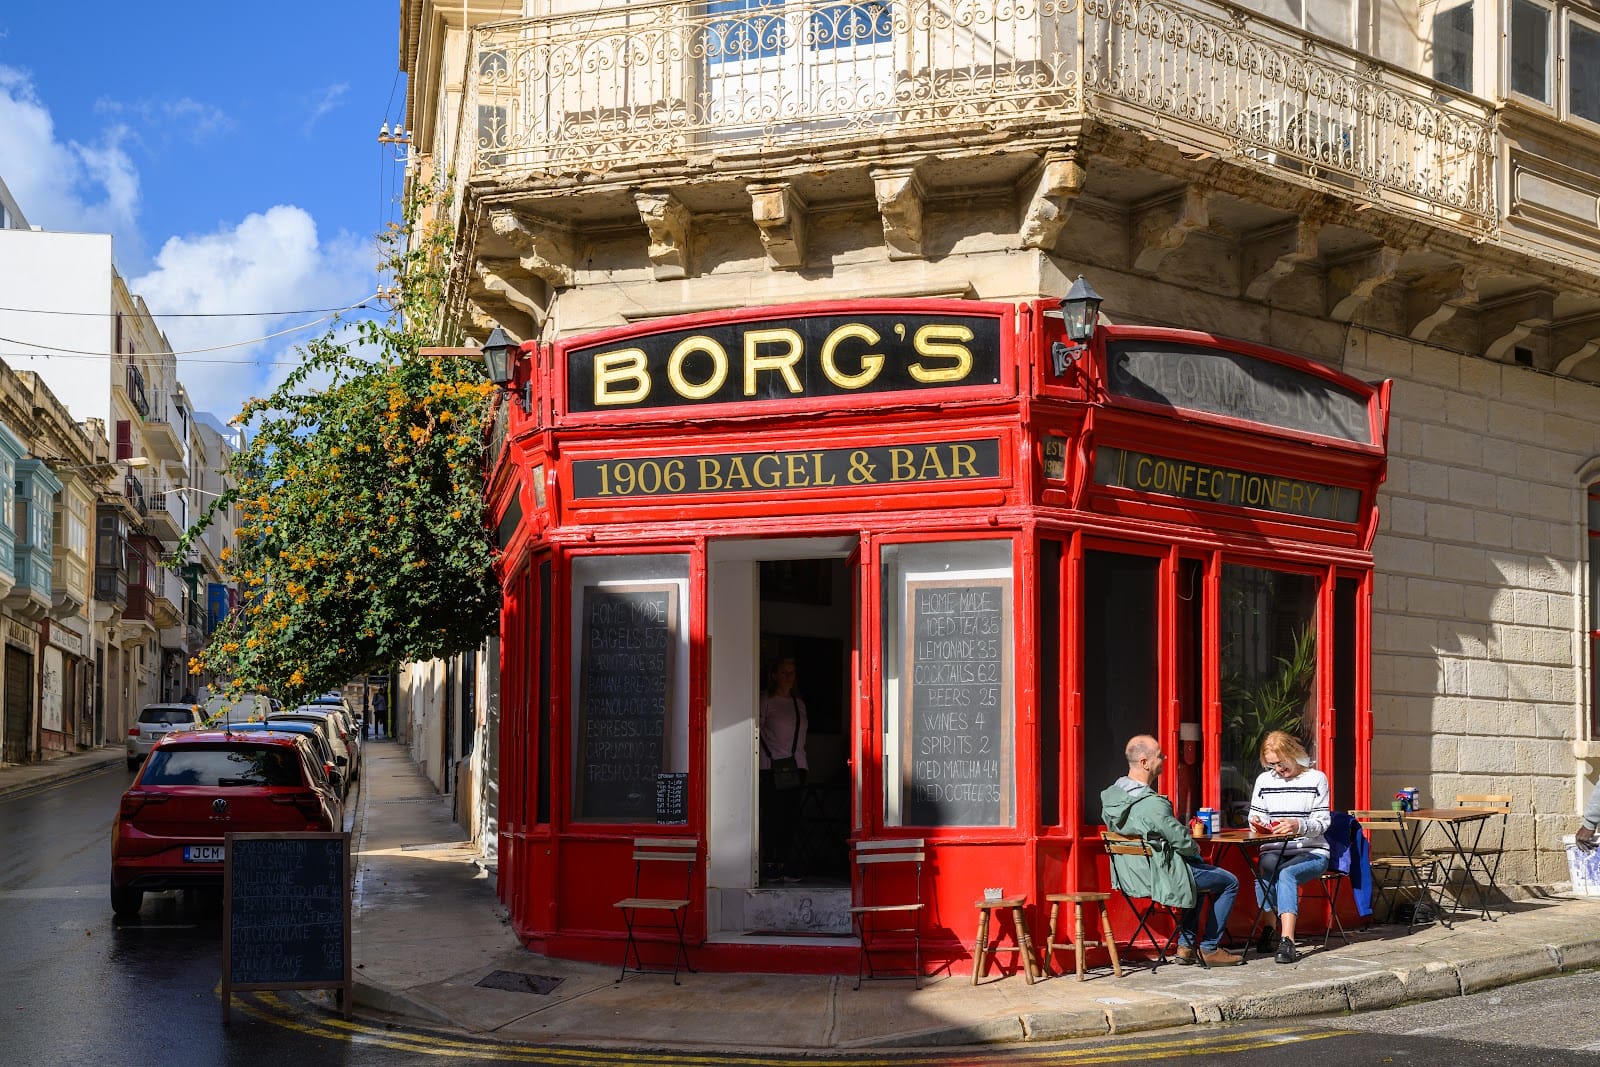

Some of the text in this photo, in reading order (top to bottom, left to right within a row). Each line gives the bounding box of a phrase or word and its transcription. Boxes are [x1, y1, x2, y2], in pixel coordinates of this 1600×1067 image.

[593, 322, 975, 406] BORG'S
[597, 444, 980, 496] 1906 BAGEL & BAR
[1136, 457, 1320, 513] CONFECTIONERY
[631, 600, 665, 623] MADE
[921, 591, 993, 613] HOME MADE
[927, 617, 955, 636] ICED
[954, 616, 978, 636] TEA
[591, 628, 641, 648] BAGELS
[919, 640, 975, 659] LEMONADE
[915, 664, 975, 684] COCKTAILS
[928, 688, 971, 707] BEERS
[922, 712, 986, 731] WINES 4
[921, 735, 991, 754] SPIRITS 2
[916, 760, 941, 779] ICED
[943, 760, 980, 779] MATCHA
[193, 847, 220, 859] JCM
